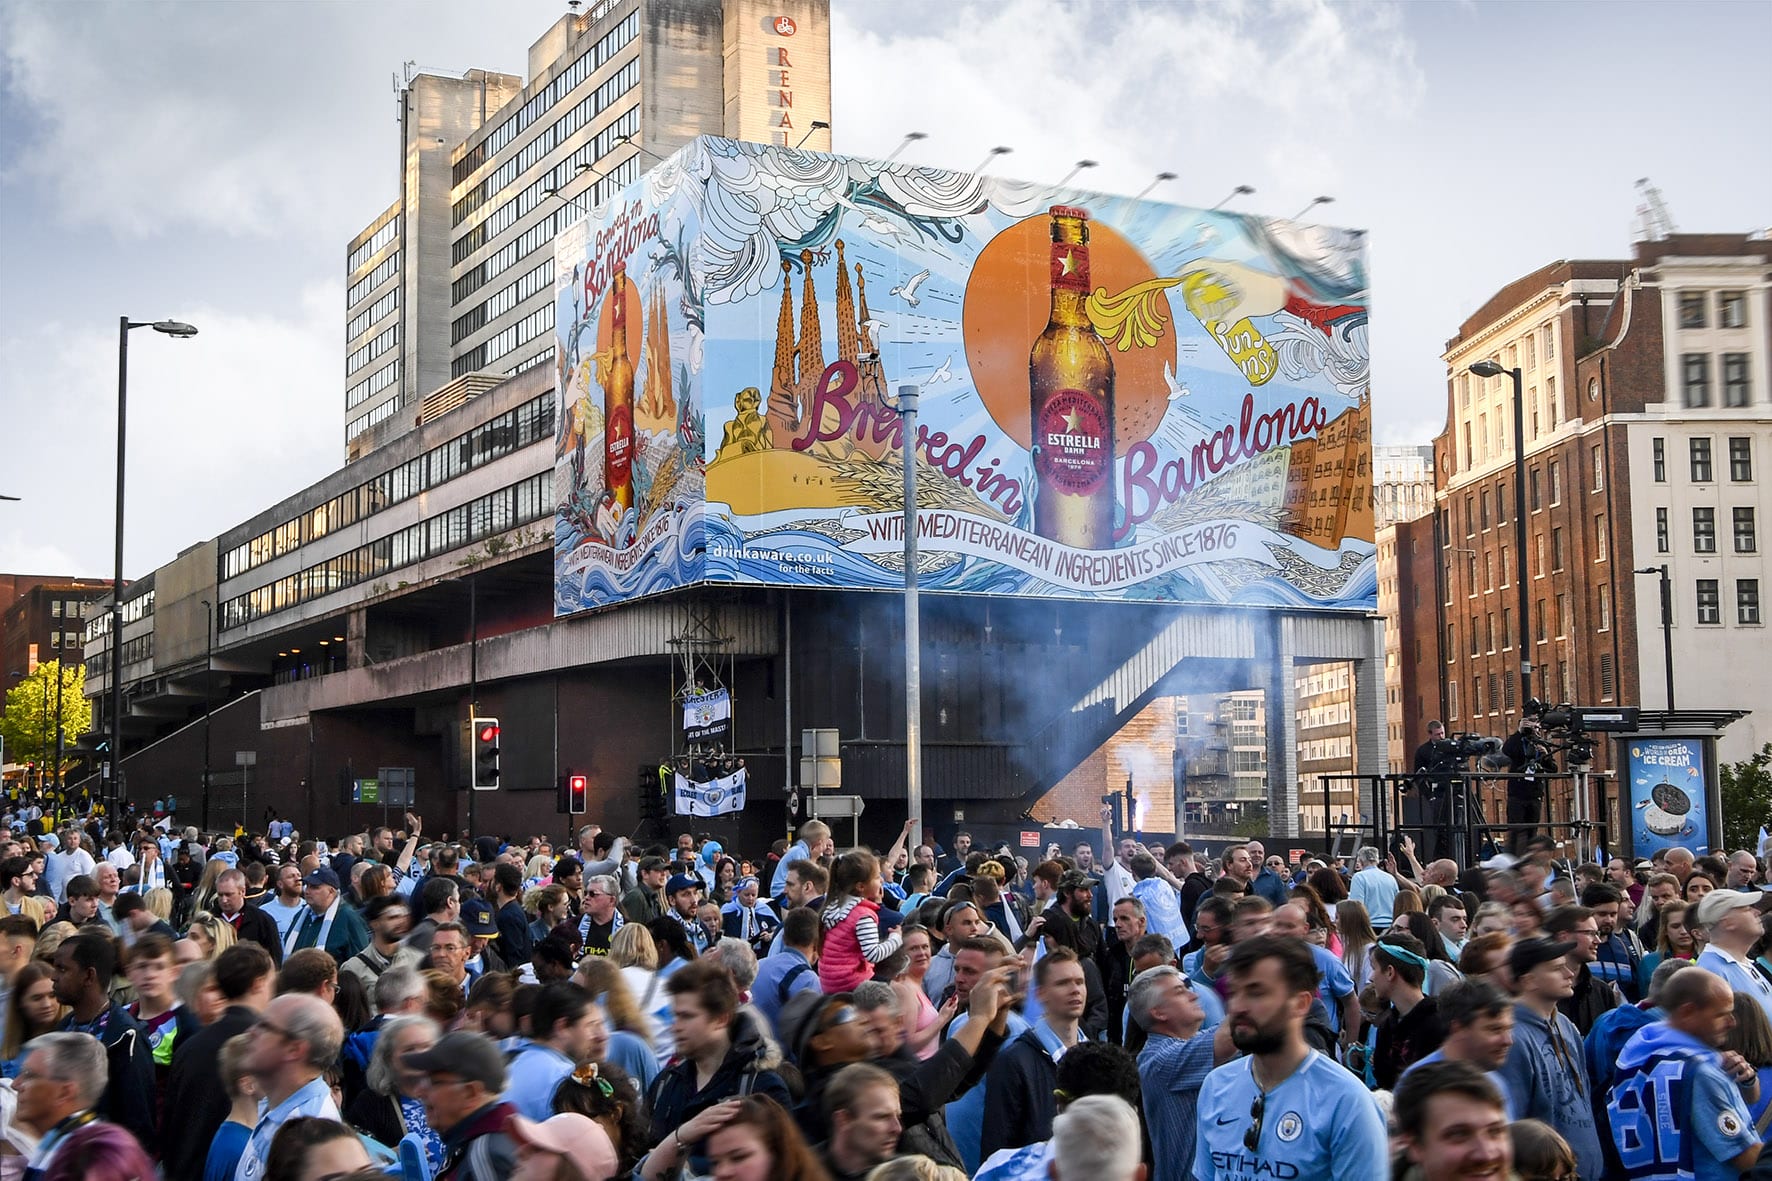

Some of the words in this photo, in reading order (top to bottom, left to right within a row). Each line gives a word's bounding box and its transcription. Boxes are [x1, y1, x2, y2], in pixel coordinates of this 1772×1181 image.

[791, 360, 987, 488] Brewed
[975, 458, 1023, 515] in
[1047, 433, 1101, 449] ESTRELLA
[1064, 446, 1085, 455] DAMM
[1054, 457, 1095, 466] BARCELONA
[1112, 393, 1327, 542] Barcelona
[713, 545, 834, 563] drinkaware.co.uk
[916, 513, 1054, 572] MEDITERRANEAN
[1054, 550, 1154, 587] INGREDIENTS
[1152, 531, 1196, 569] SINCE
[1194, 523, 1241, 553] 1876
[779, 563, 793, 573] for
[794, 564, 810, 574] the
[812, 565, 834, 575] facts
[1668, 745, 1688, 756] OREO
[1643, 755, 1657, 765] ICE
[1658, 754, 1690, 767] CREAM
[1657, 1092, 1670, 1130] SINCE
[1211, 1151, 1299, 1180] ETIHAD
